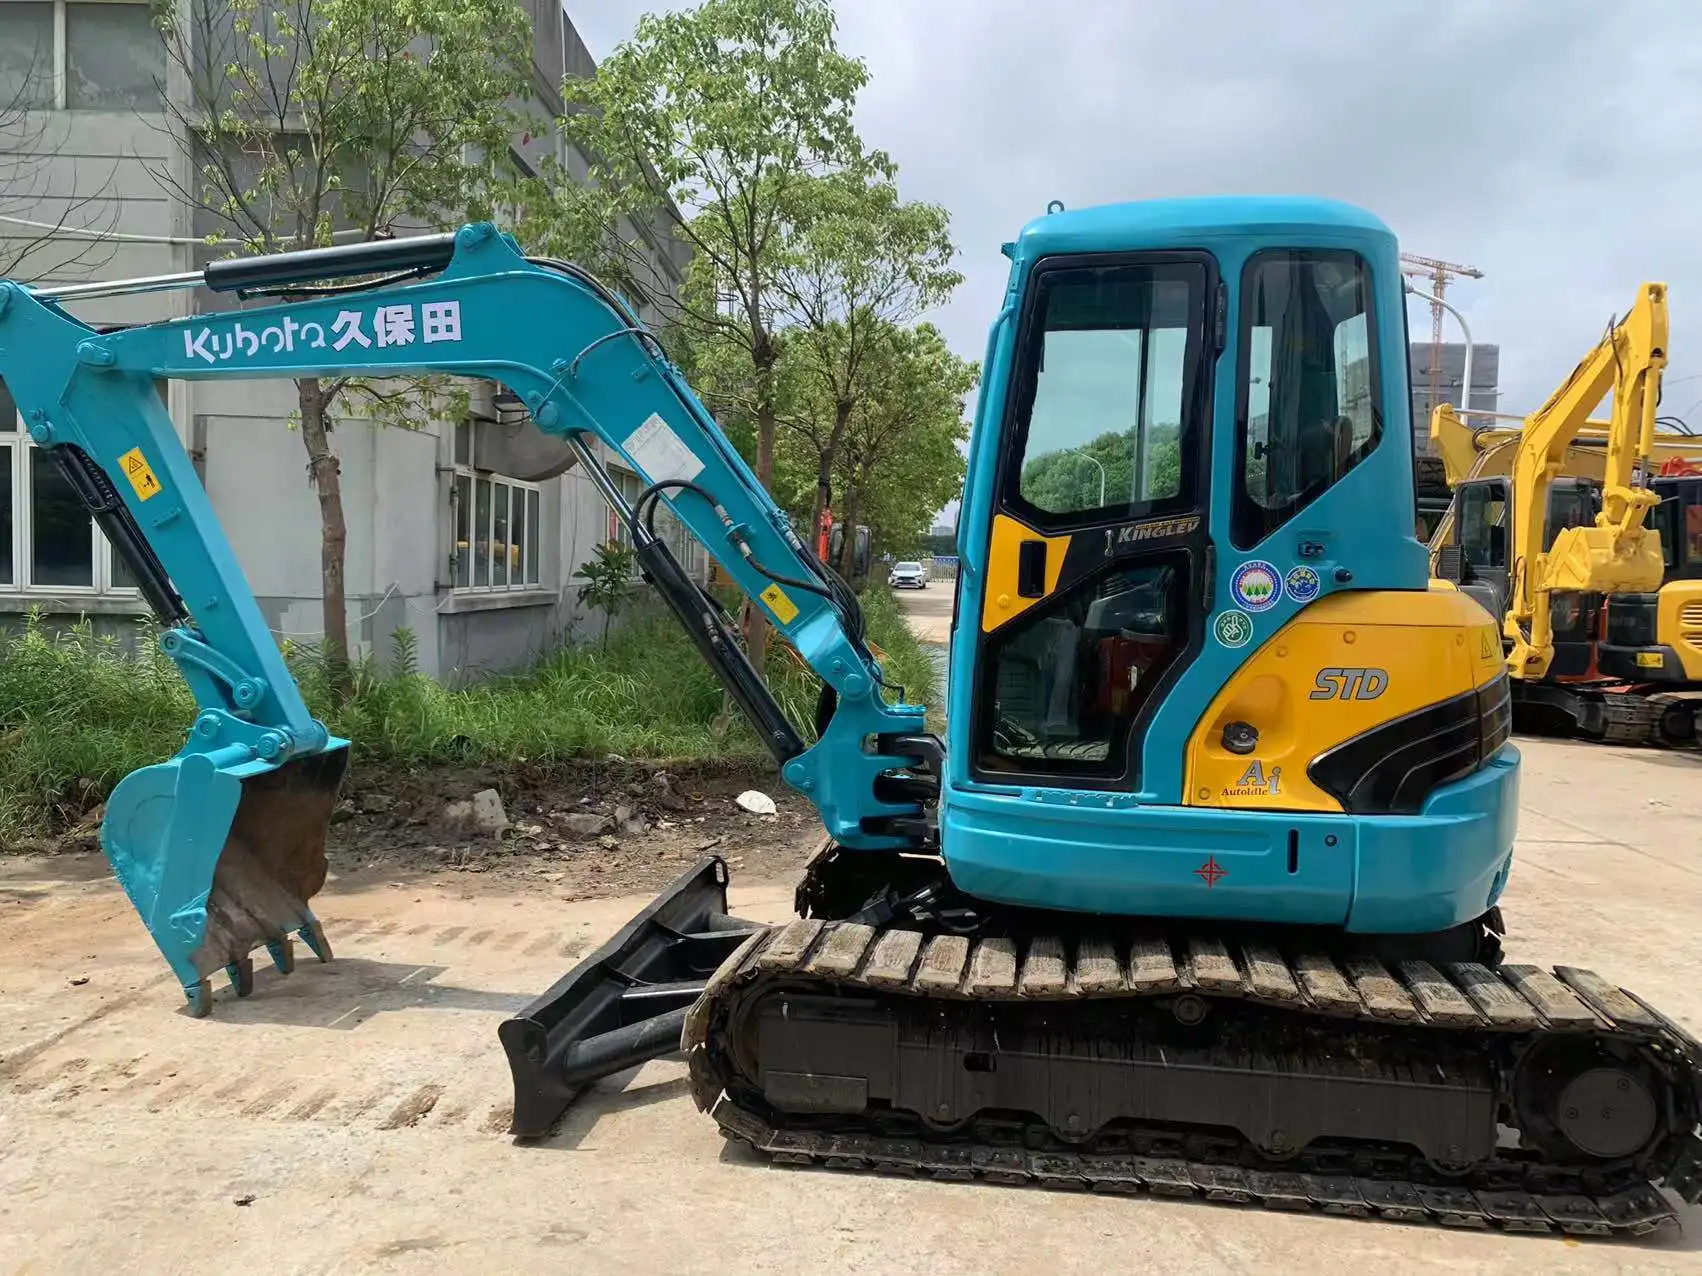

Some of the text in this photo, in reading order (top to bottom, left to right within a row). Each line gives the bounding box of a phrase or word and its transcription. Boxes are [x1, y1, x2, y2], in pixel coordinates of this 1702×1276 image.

[184, 300, 463, 364] Kubota 久保田
[1309, 667, 1389, 701] STD
[1236, 759, 1281, 795] Ai
